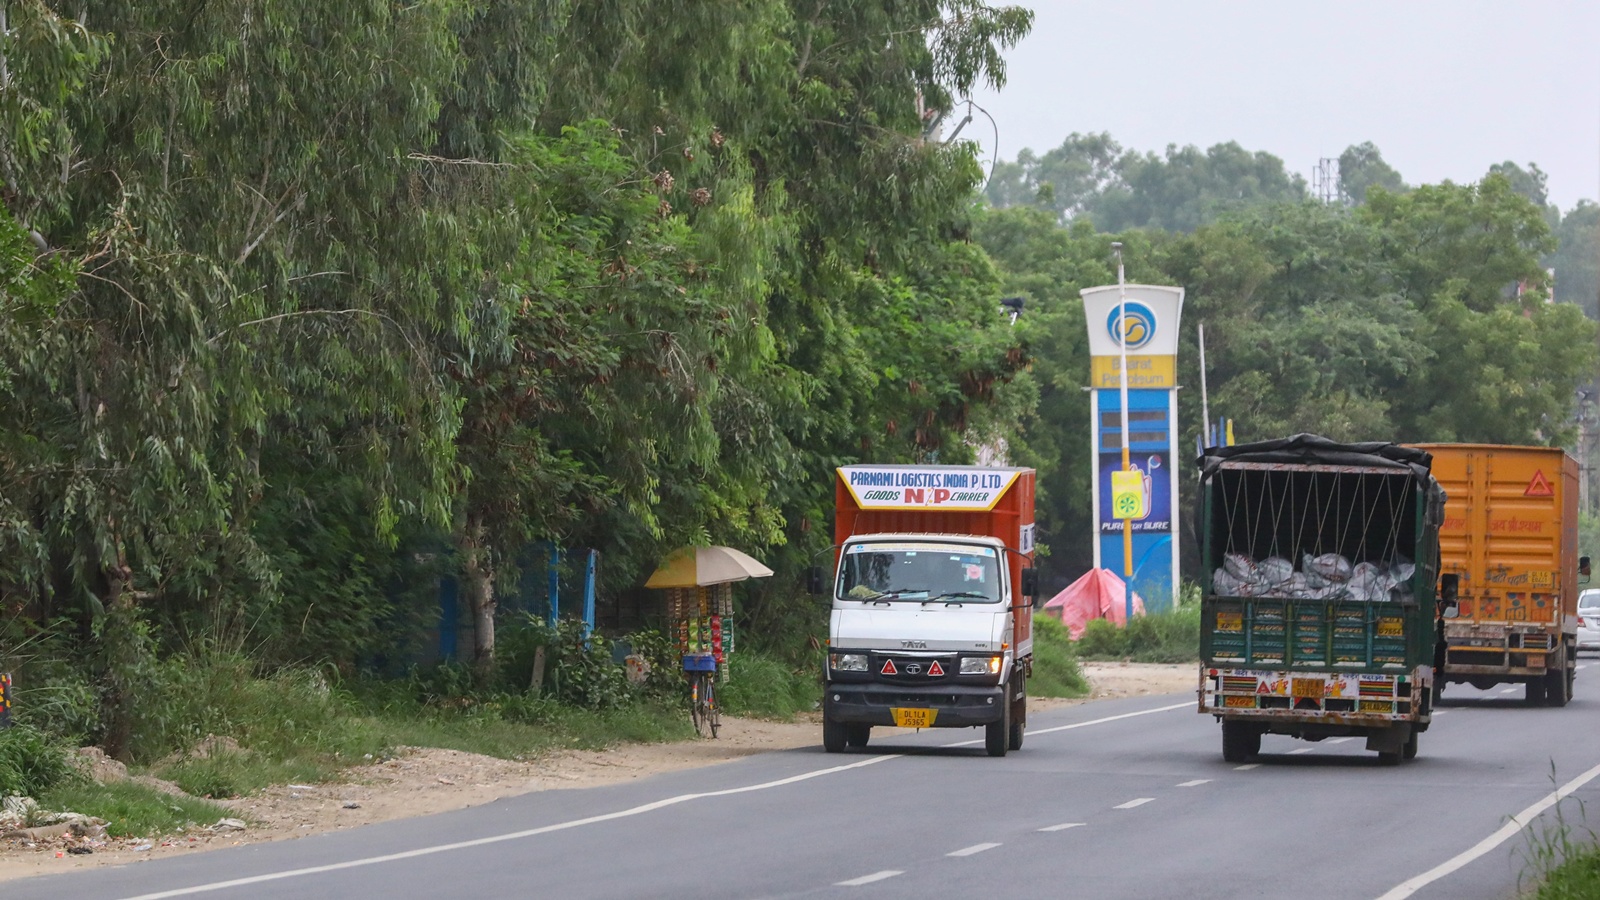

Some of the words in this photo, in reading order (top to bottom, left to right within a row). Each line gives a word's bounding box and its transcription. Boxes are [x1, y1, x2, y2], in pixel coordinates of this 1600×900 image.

[851, 471, 894, 486] PARNAMI
[896, 472, 942, 488] LOGISTICS
[943, 473, 968, 488] INDIA
[863, 490, 901, 501] GOODS
[950, 491, 990, 502] CARRIER
[901, 640, 927, 649] TATA
[904, 718, 925, 726] J5365
